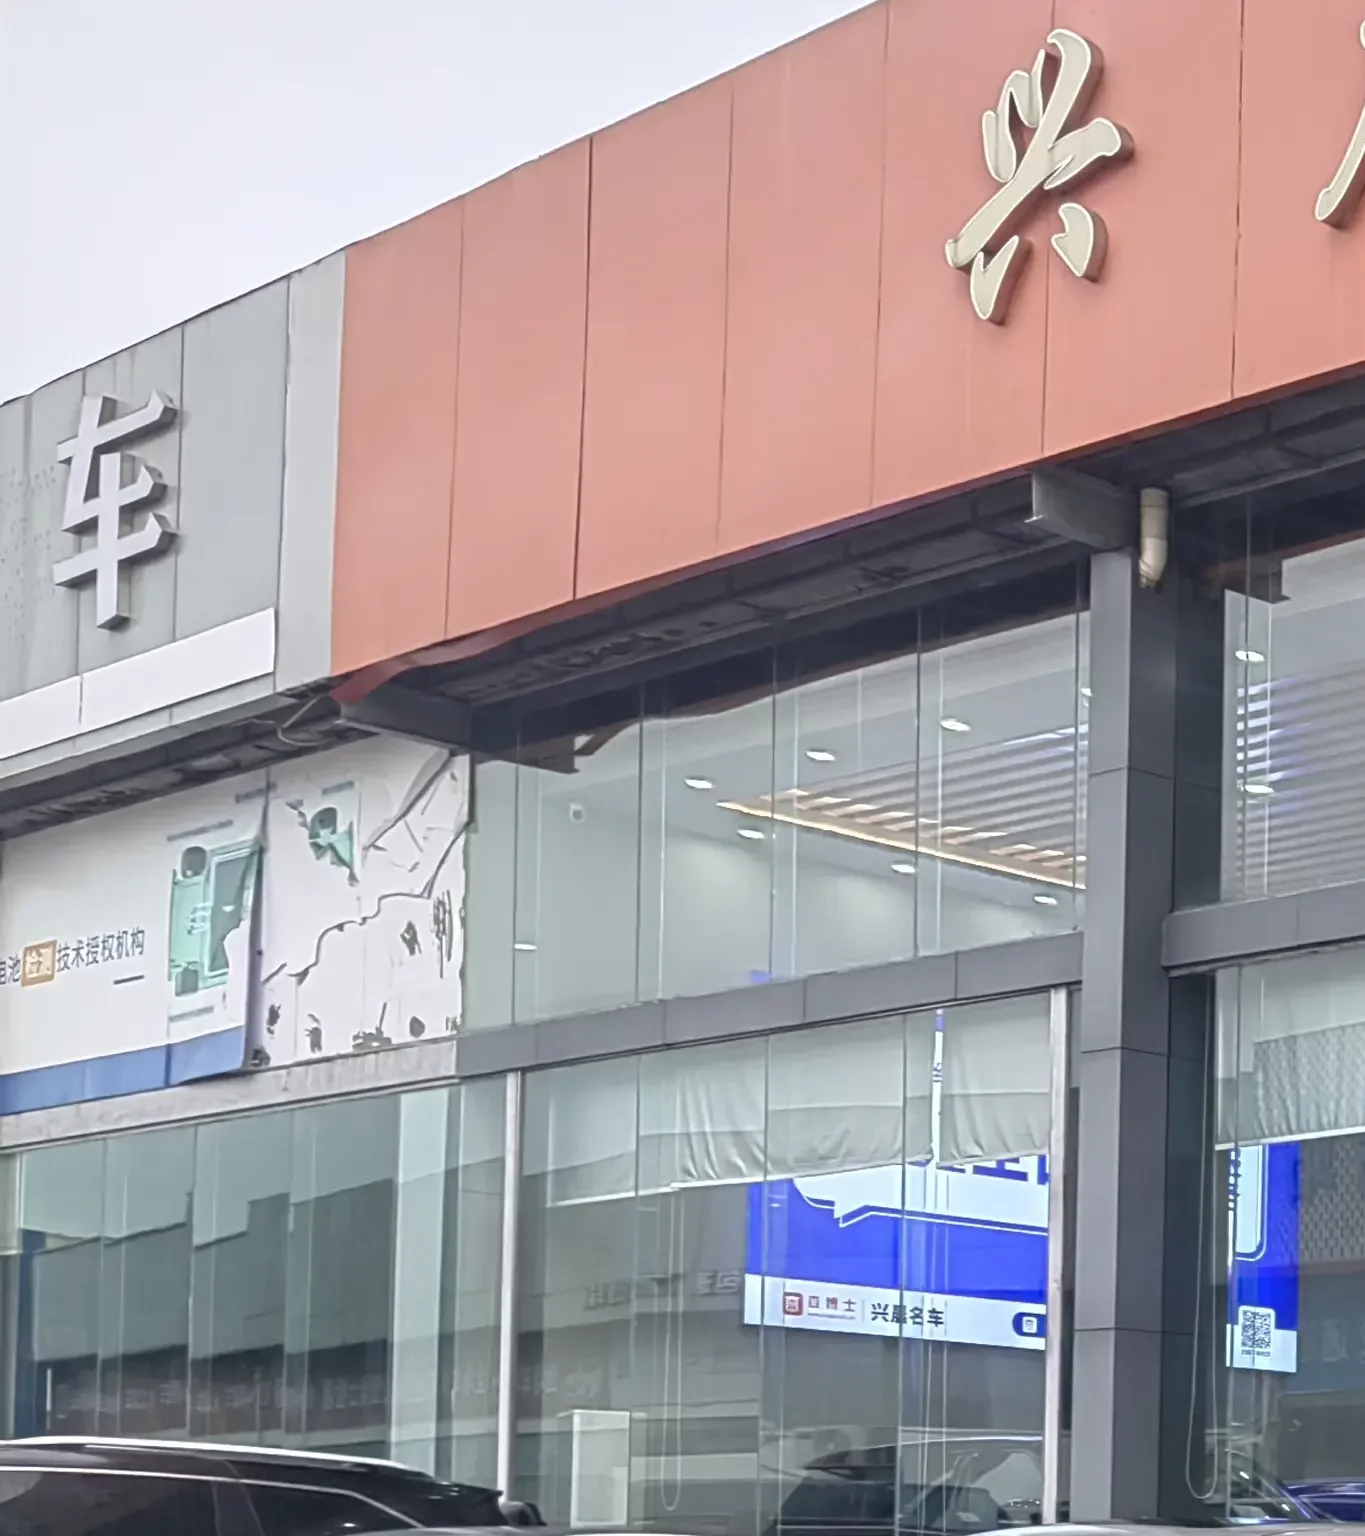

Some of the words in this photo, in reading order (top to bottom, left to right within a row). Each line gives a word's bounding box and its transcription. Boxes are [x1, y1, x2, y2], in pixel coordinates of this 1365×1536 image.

[52, 390, 178, 628] 车
[57, 927, 145, 972] 技术授权机构
[870, 1302, 945, 1328] 兴晨名车
